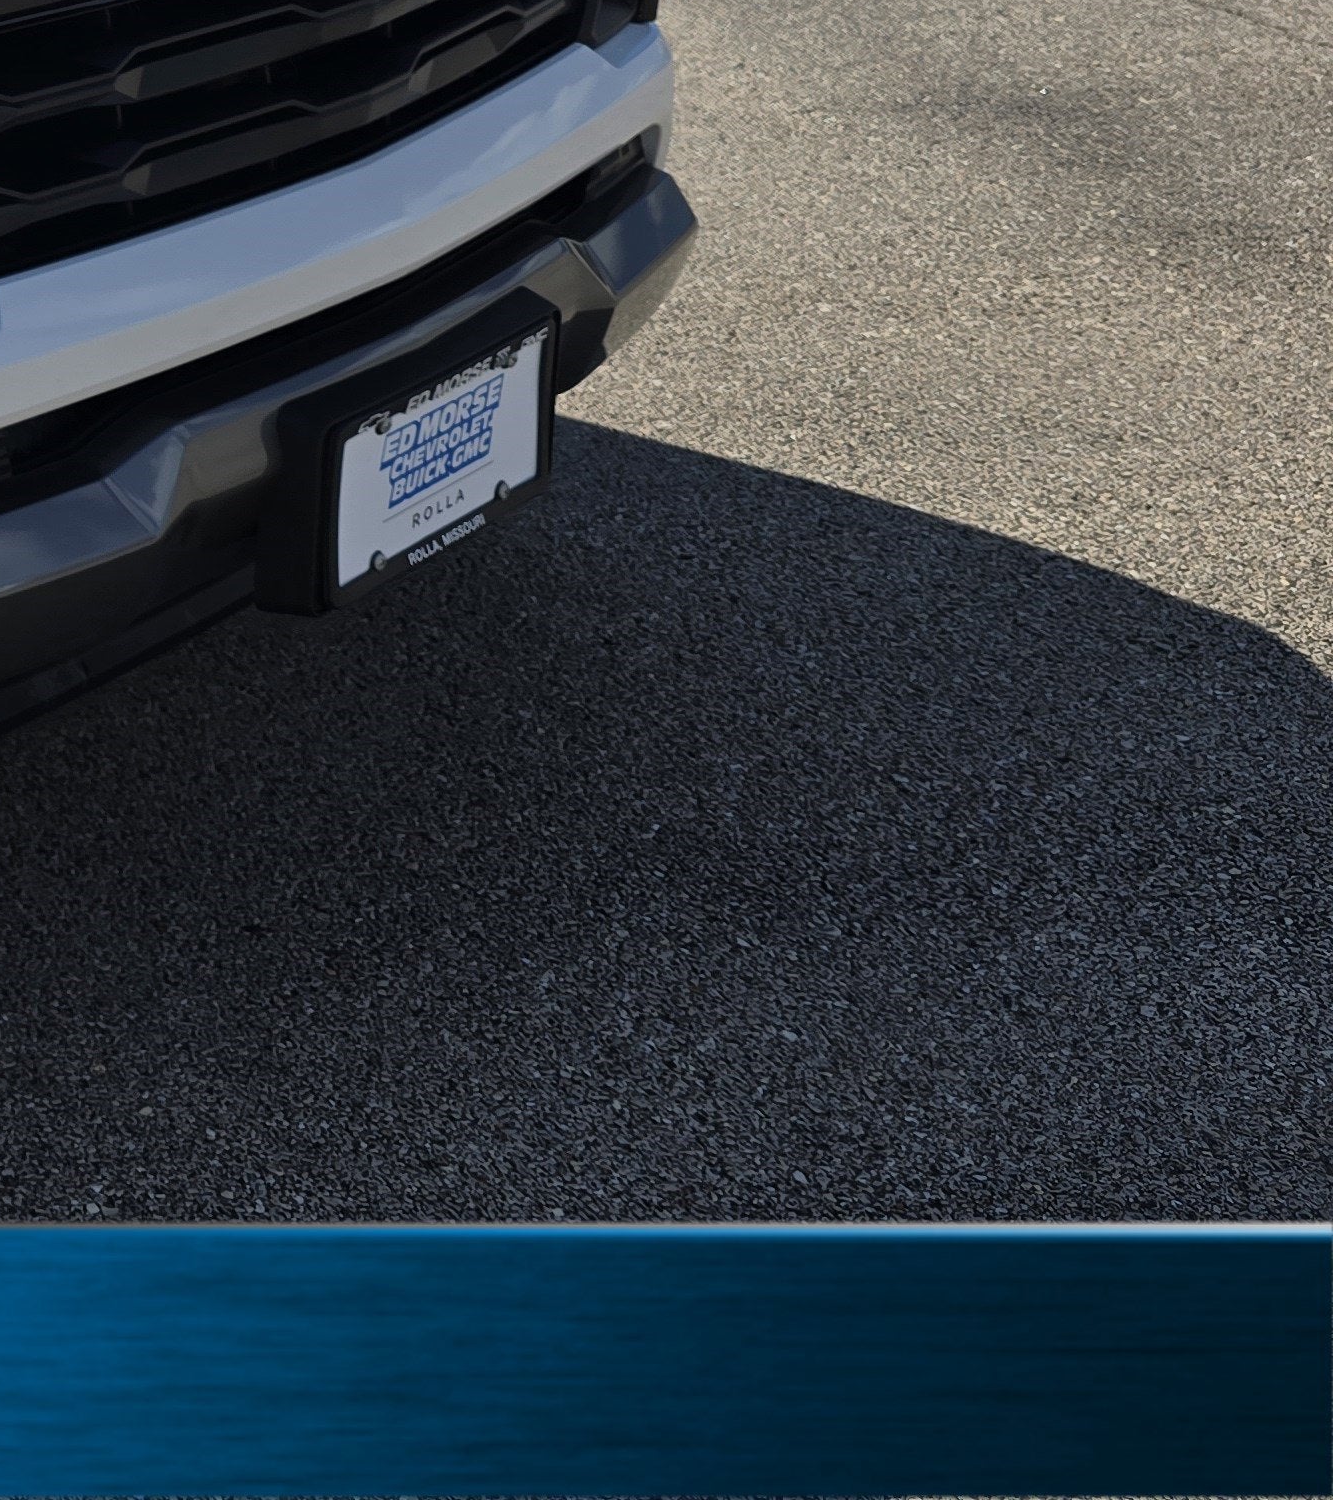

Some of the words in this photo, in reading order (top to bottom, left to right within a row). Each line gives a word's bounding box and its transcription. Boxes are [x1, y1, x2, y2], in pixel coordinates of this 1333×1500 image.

[385, 423, 418, 460] ED
[419, 376, 503, 442] MORSE
[411, 488, 465, 529] ROLLA
[441, 512, 486, 547] MISSOURI
